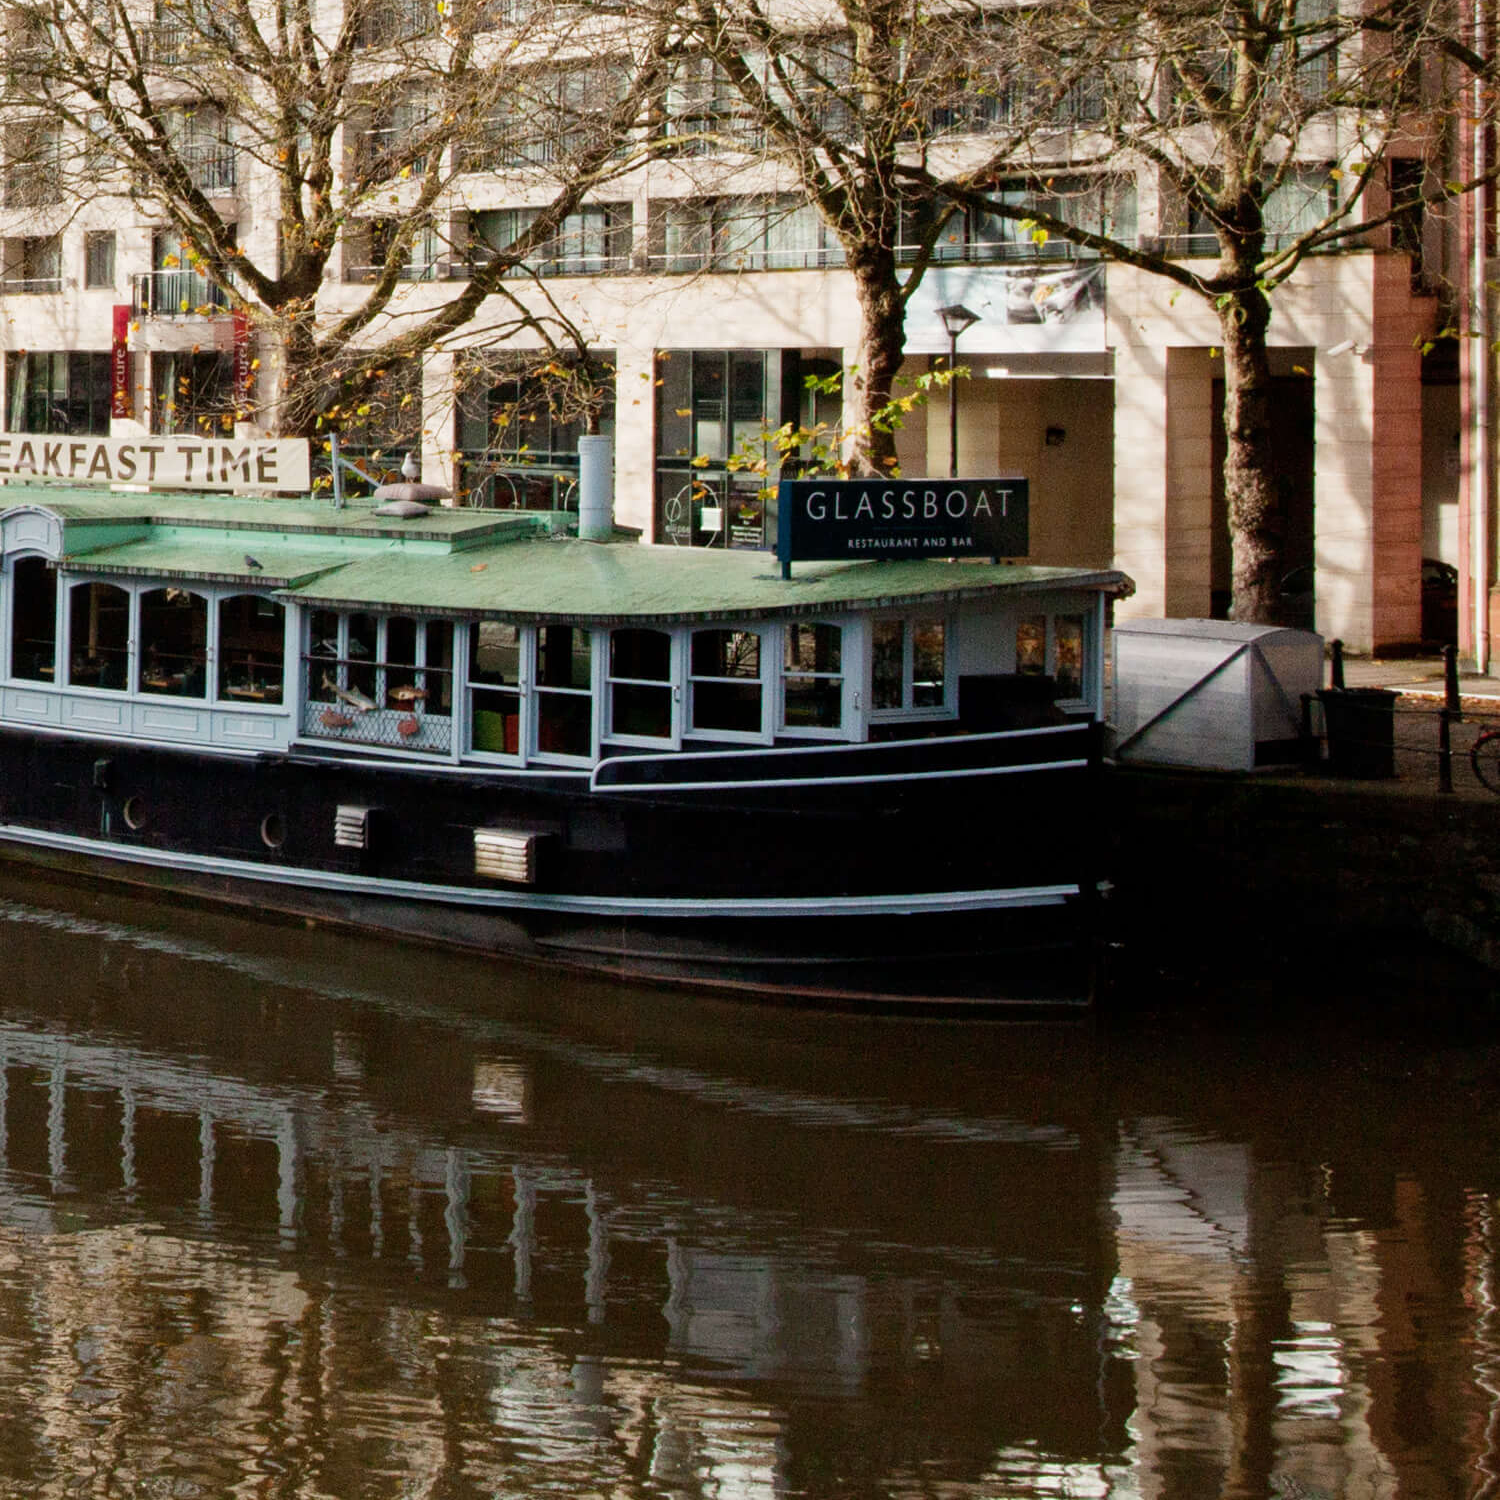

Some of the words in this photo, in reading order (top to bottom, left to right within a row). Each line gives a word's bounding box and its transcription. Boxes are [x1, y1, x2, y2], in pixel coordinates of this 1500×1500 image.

[115, 347, 126, 415] Mrcure
[177, 445, 279, 483] TIME
[806, 489, 1013, 520] GLASSBOAT
[848, 538, 918, 549] RESTAURANT
[922, 536, 947, 548] AND
[951, 536, 973, 547] BAR
